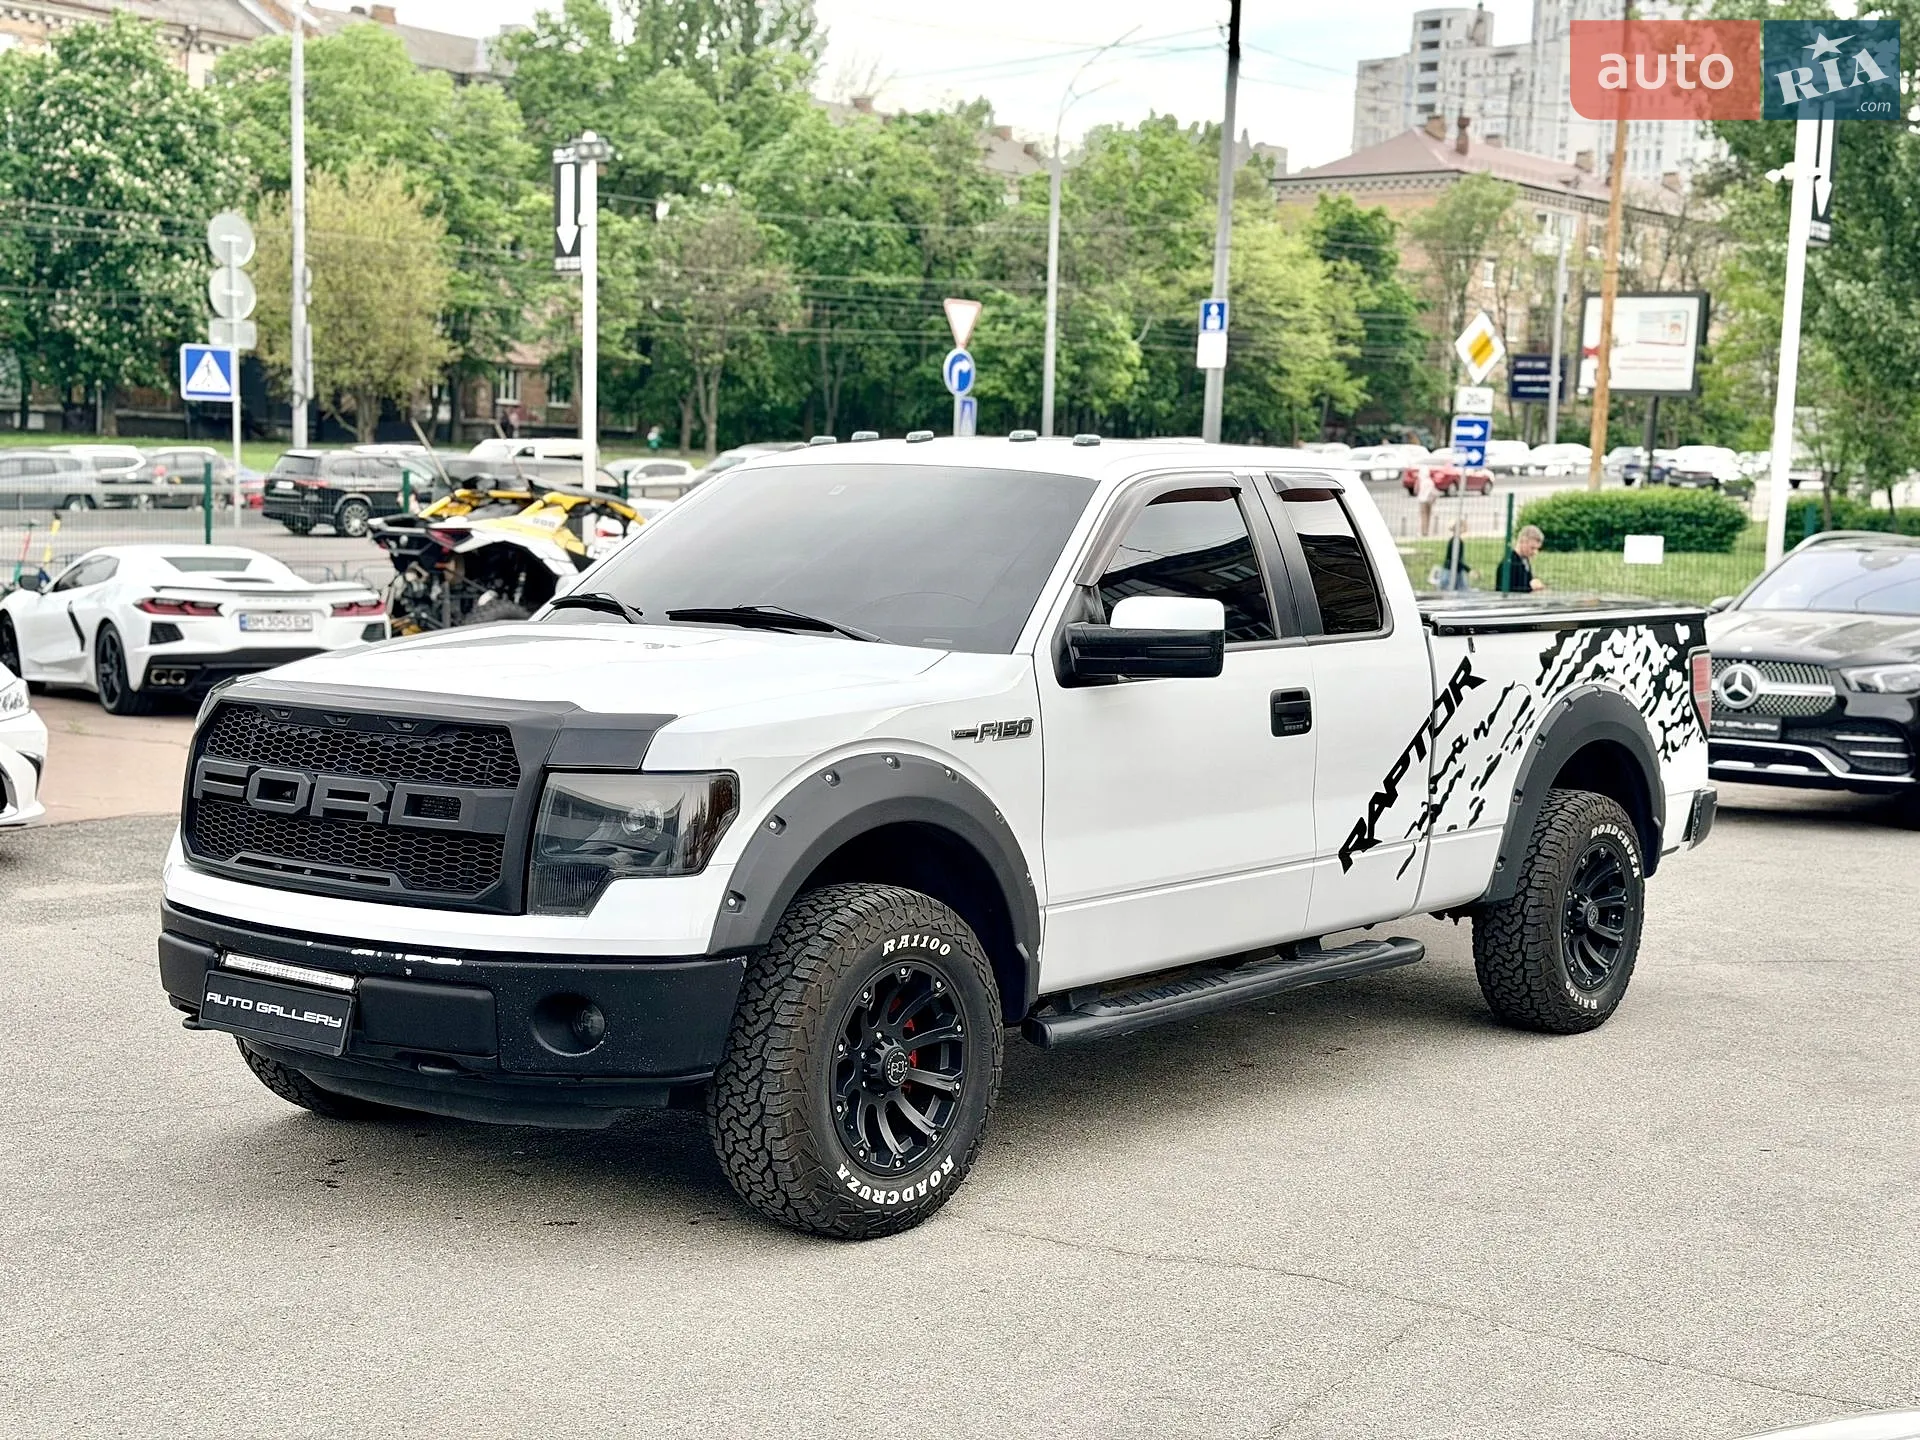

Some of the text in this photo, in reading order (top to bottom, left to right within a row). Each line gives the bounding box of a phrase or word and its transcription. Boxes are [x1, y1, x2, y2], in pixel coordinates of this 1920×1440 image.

[1338, 656, 1487, 875] RAPTOR
[194, 757, 474, 832] FORD
[1590, 823, 1640, 879] ROADCRUZA
[882, 934, 952, 957] RA1100
[206, 992, 342, 1028] AUTO GALLERY
[836, 1154, 954, 1205] ROADCRUZA
